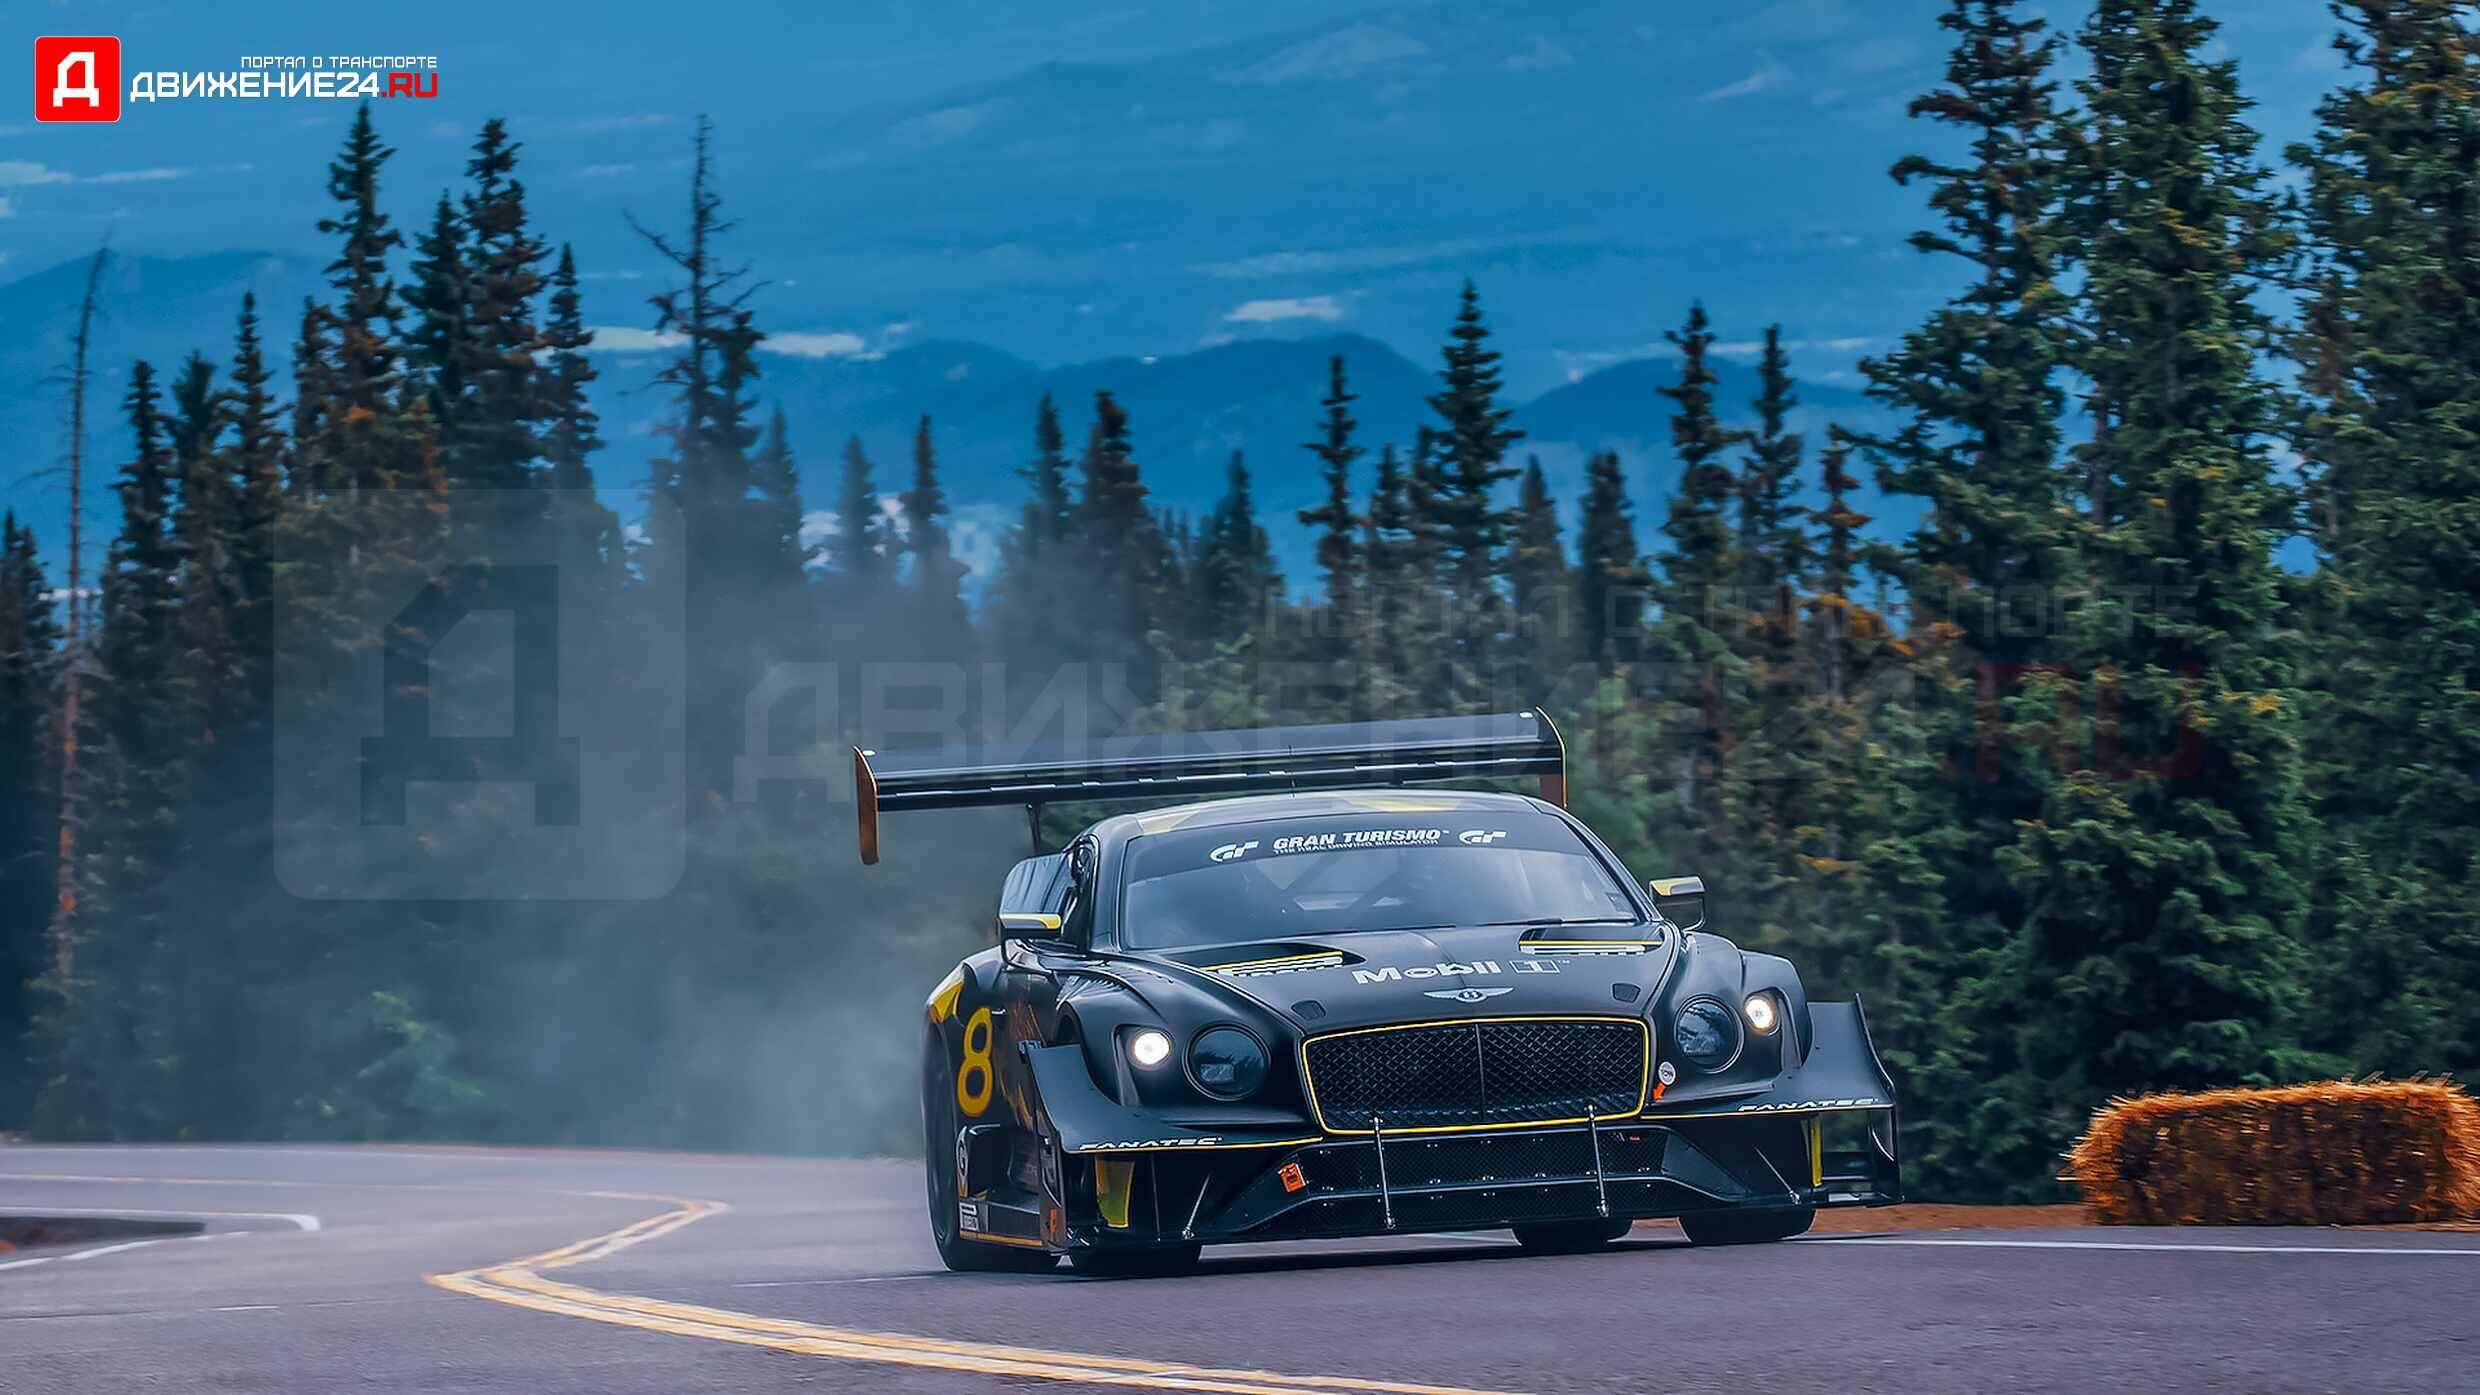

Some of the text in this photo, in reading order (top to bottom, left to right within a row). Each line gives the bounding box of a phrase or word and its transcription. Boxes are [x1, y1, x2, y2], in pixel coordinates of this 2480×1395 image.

[1273, 829, 1440, 849] GRAN TURISMO
[1352, 961, 1501, 984] Mobil
[958, 1007, 993, 1117] 8
[1739, 1098, 1875, 1112] FANATEC
[1079, 1136, 1218, 1151] FANATEC
